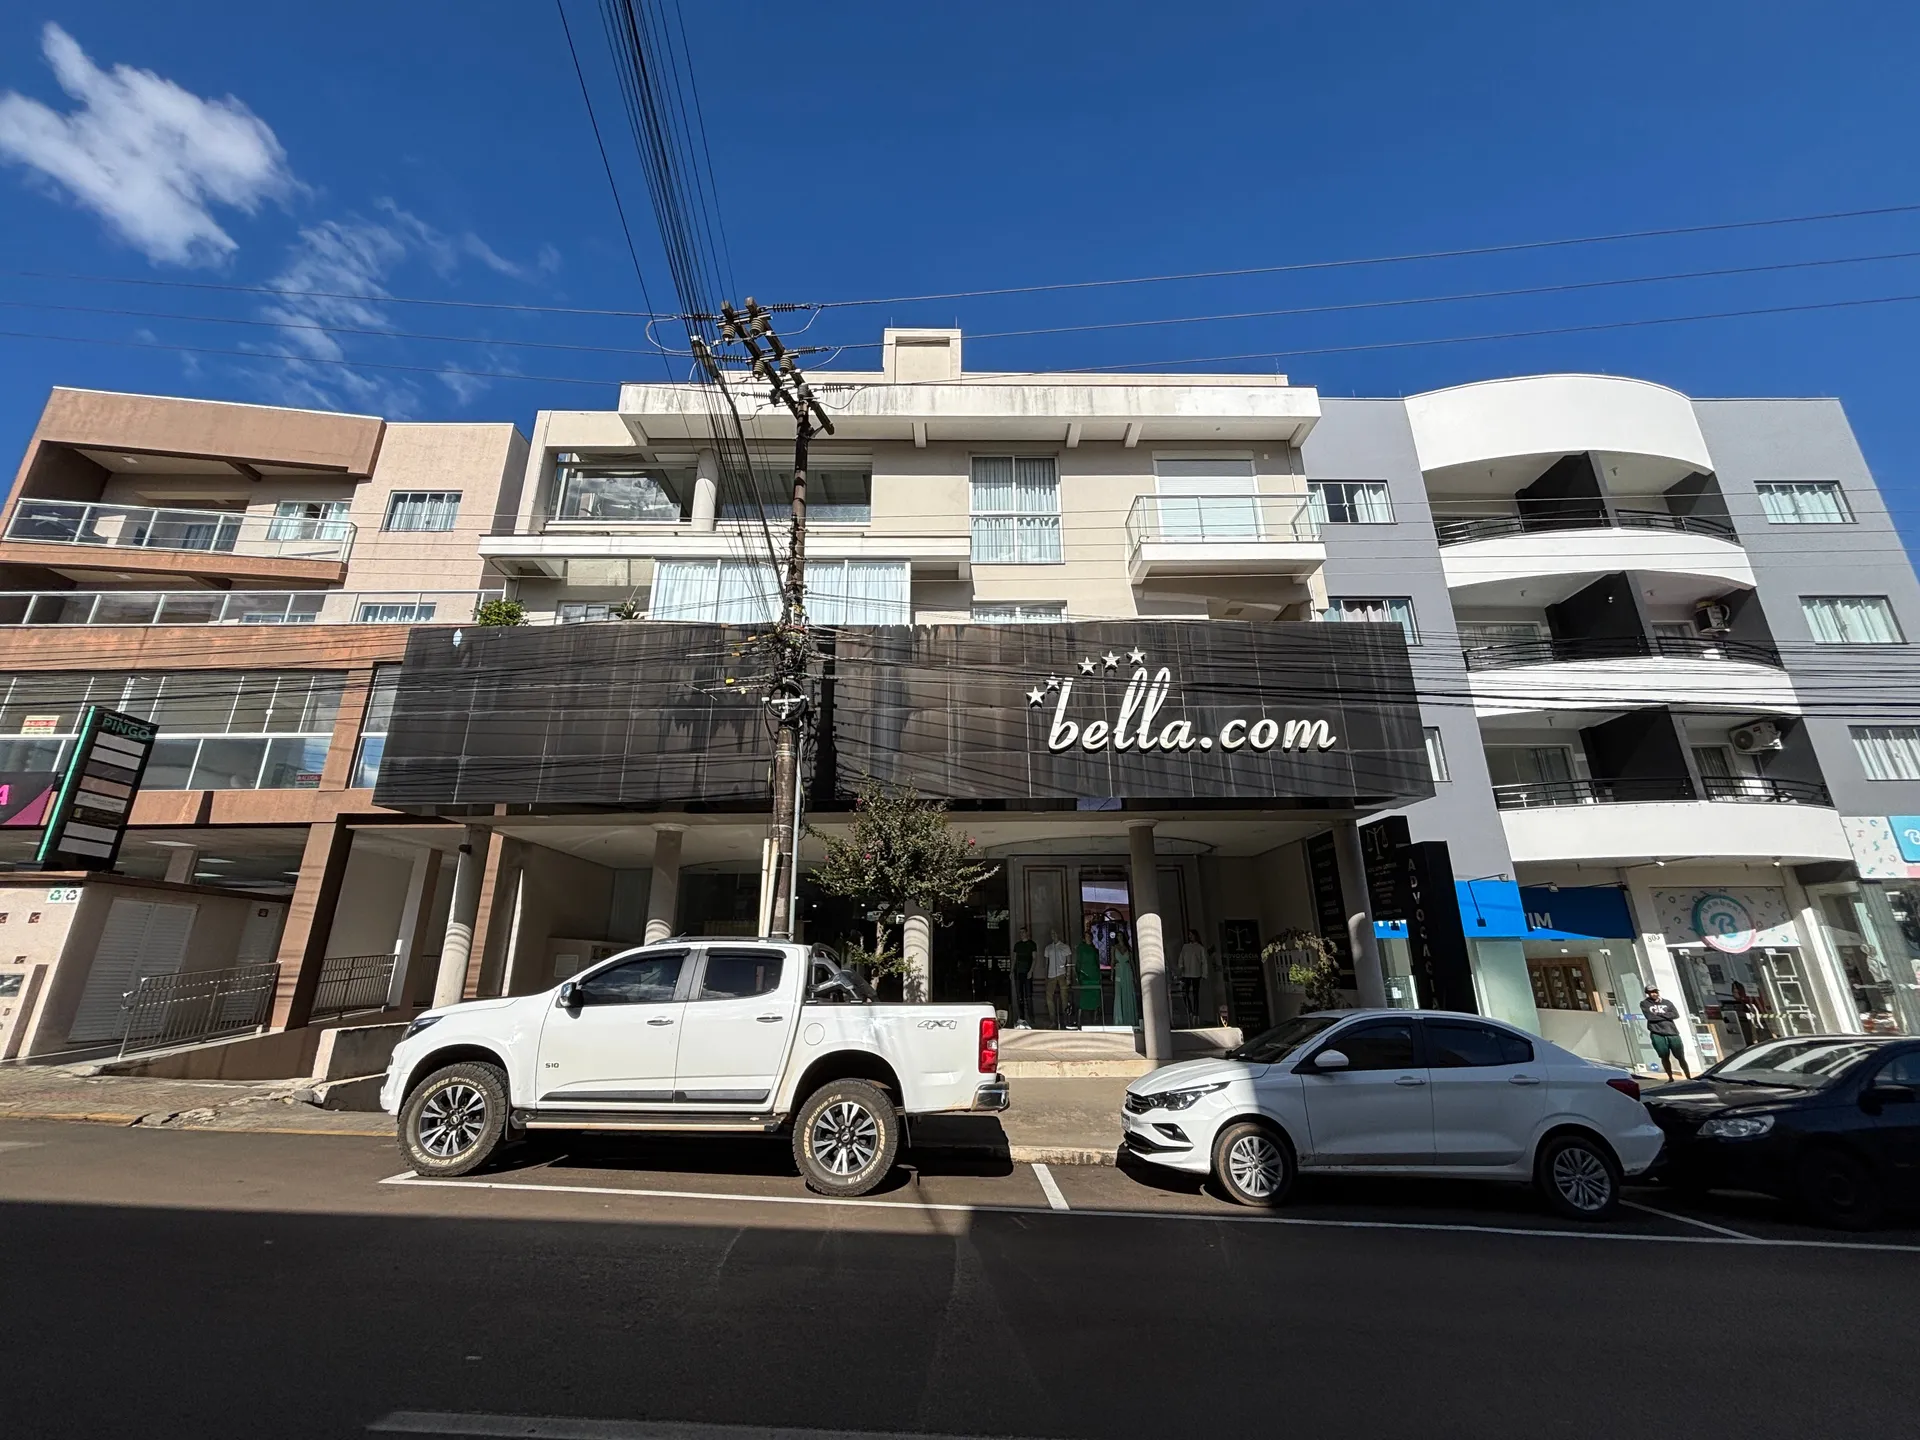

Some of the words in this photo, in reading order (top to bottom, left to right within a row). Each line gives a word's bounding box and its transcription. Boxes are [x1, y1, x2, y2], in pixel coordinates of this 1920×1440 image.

[1048, 667, 1337, 750] bella.com
[102, 717, 151, 740] PINGO
[1524, 912, 1553, 929] IM
[1407, 858, 1439, 1010] ADVOCACIA
[452, 1077, 478, 1086] Brutus
[807, 1102, 829, 1126] Brutus
